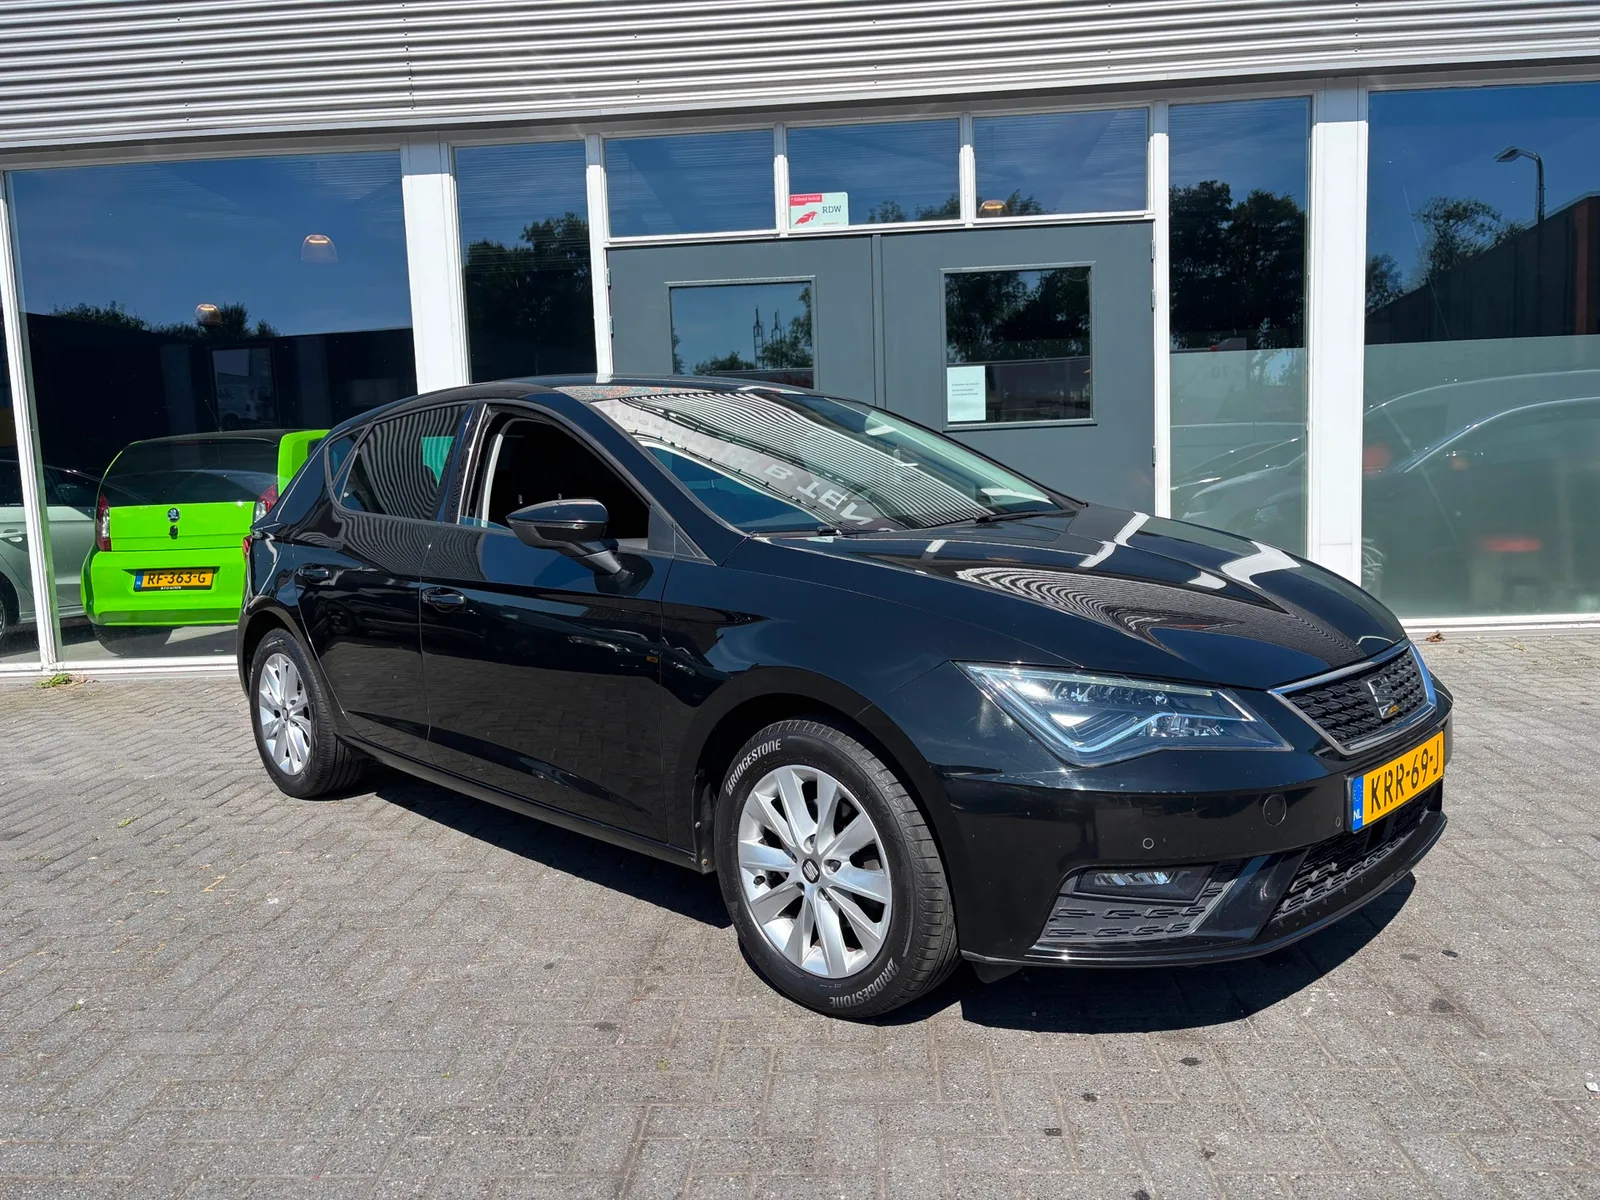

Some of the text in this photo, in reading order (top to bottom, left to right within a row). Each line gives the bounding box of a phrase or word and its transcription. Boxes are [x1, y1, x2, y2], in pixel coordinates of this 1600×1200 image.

[822, 205, 841, 214] RDW
[147, 572, 207, 585] RF-363-G
[725, 738, 781, 797] BRIDGESTONE
[1353, 740, 1440, 822] NL KRR-69-J
[829, 957, 900, 1009] BRIDGESTONE
